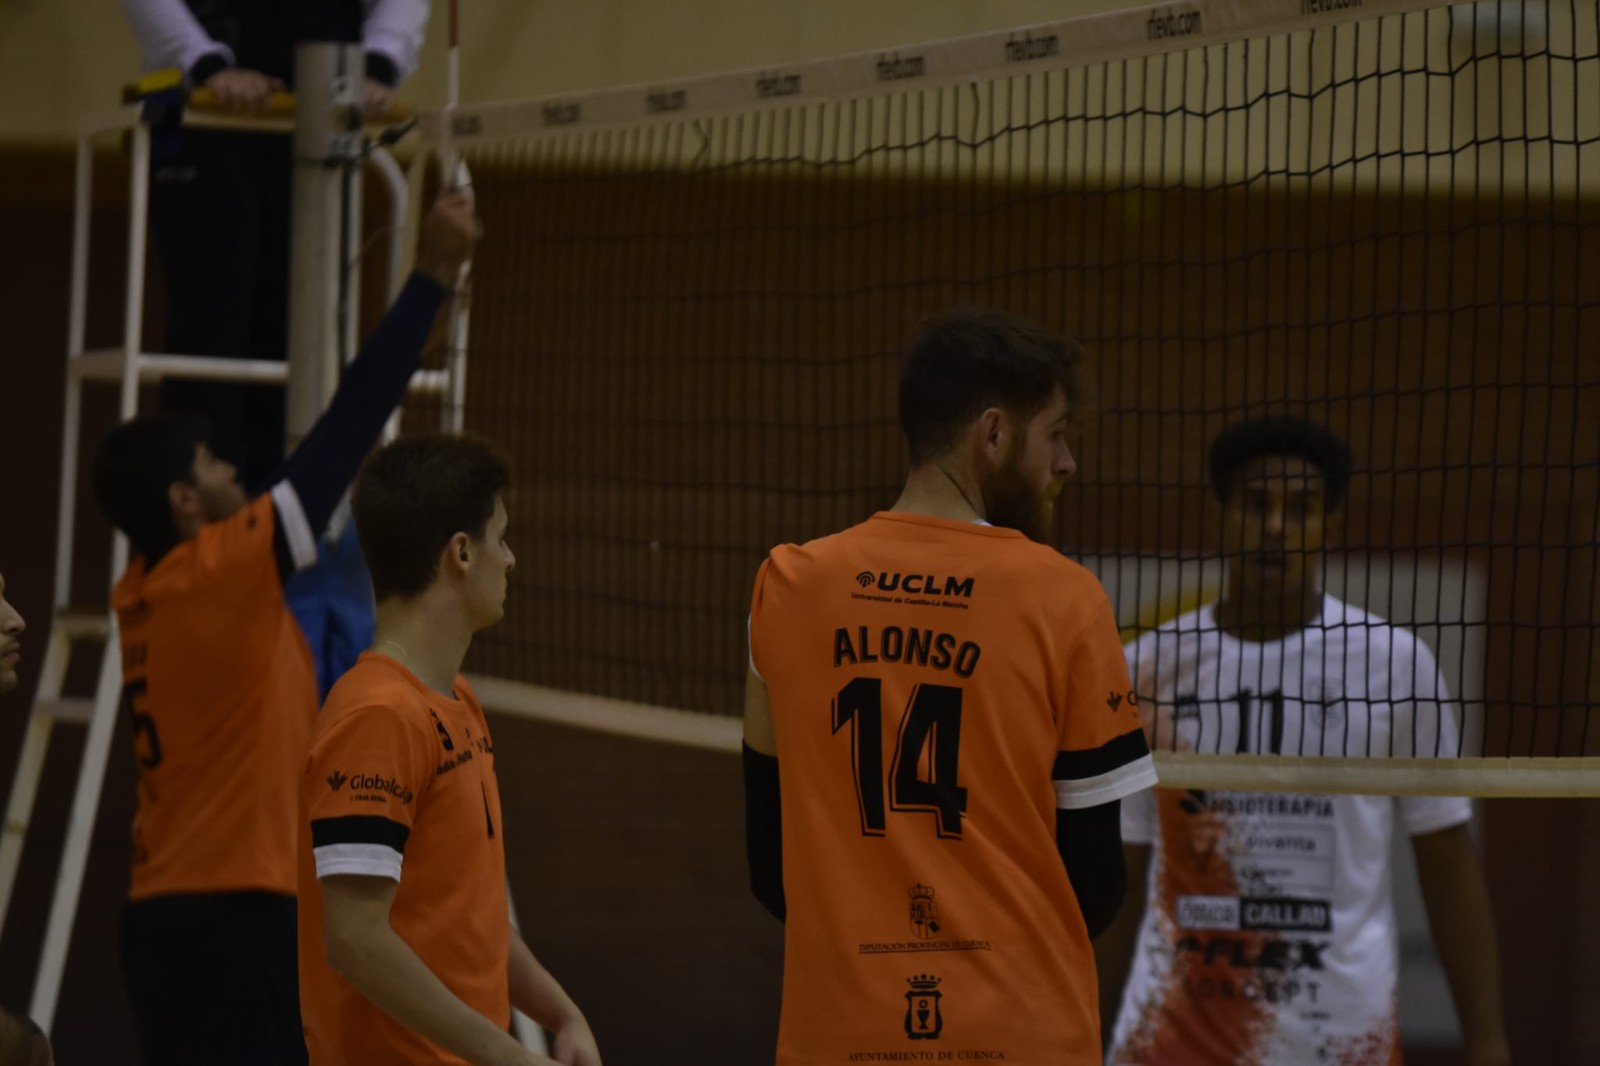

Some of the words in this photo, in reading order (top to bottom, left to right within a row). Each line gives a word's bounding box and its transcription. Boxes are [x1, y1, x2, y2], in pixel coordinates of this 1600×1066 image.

[878, 572, 975, 598] UCLM
[851, 592, 892, 603] Universidad
[942, 601, 968, 610] Mancha
[834, 626, 981, 678] ALONSO
[831, 677, 967, 841] 14
[849, 1051, 934, 1062] AYUNTAMIENTO
[938, 1050, 953, 1061] DE
[957, 1050, 1005, 1061] CUENCA
